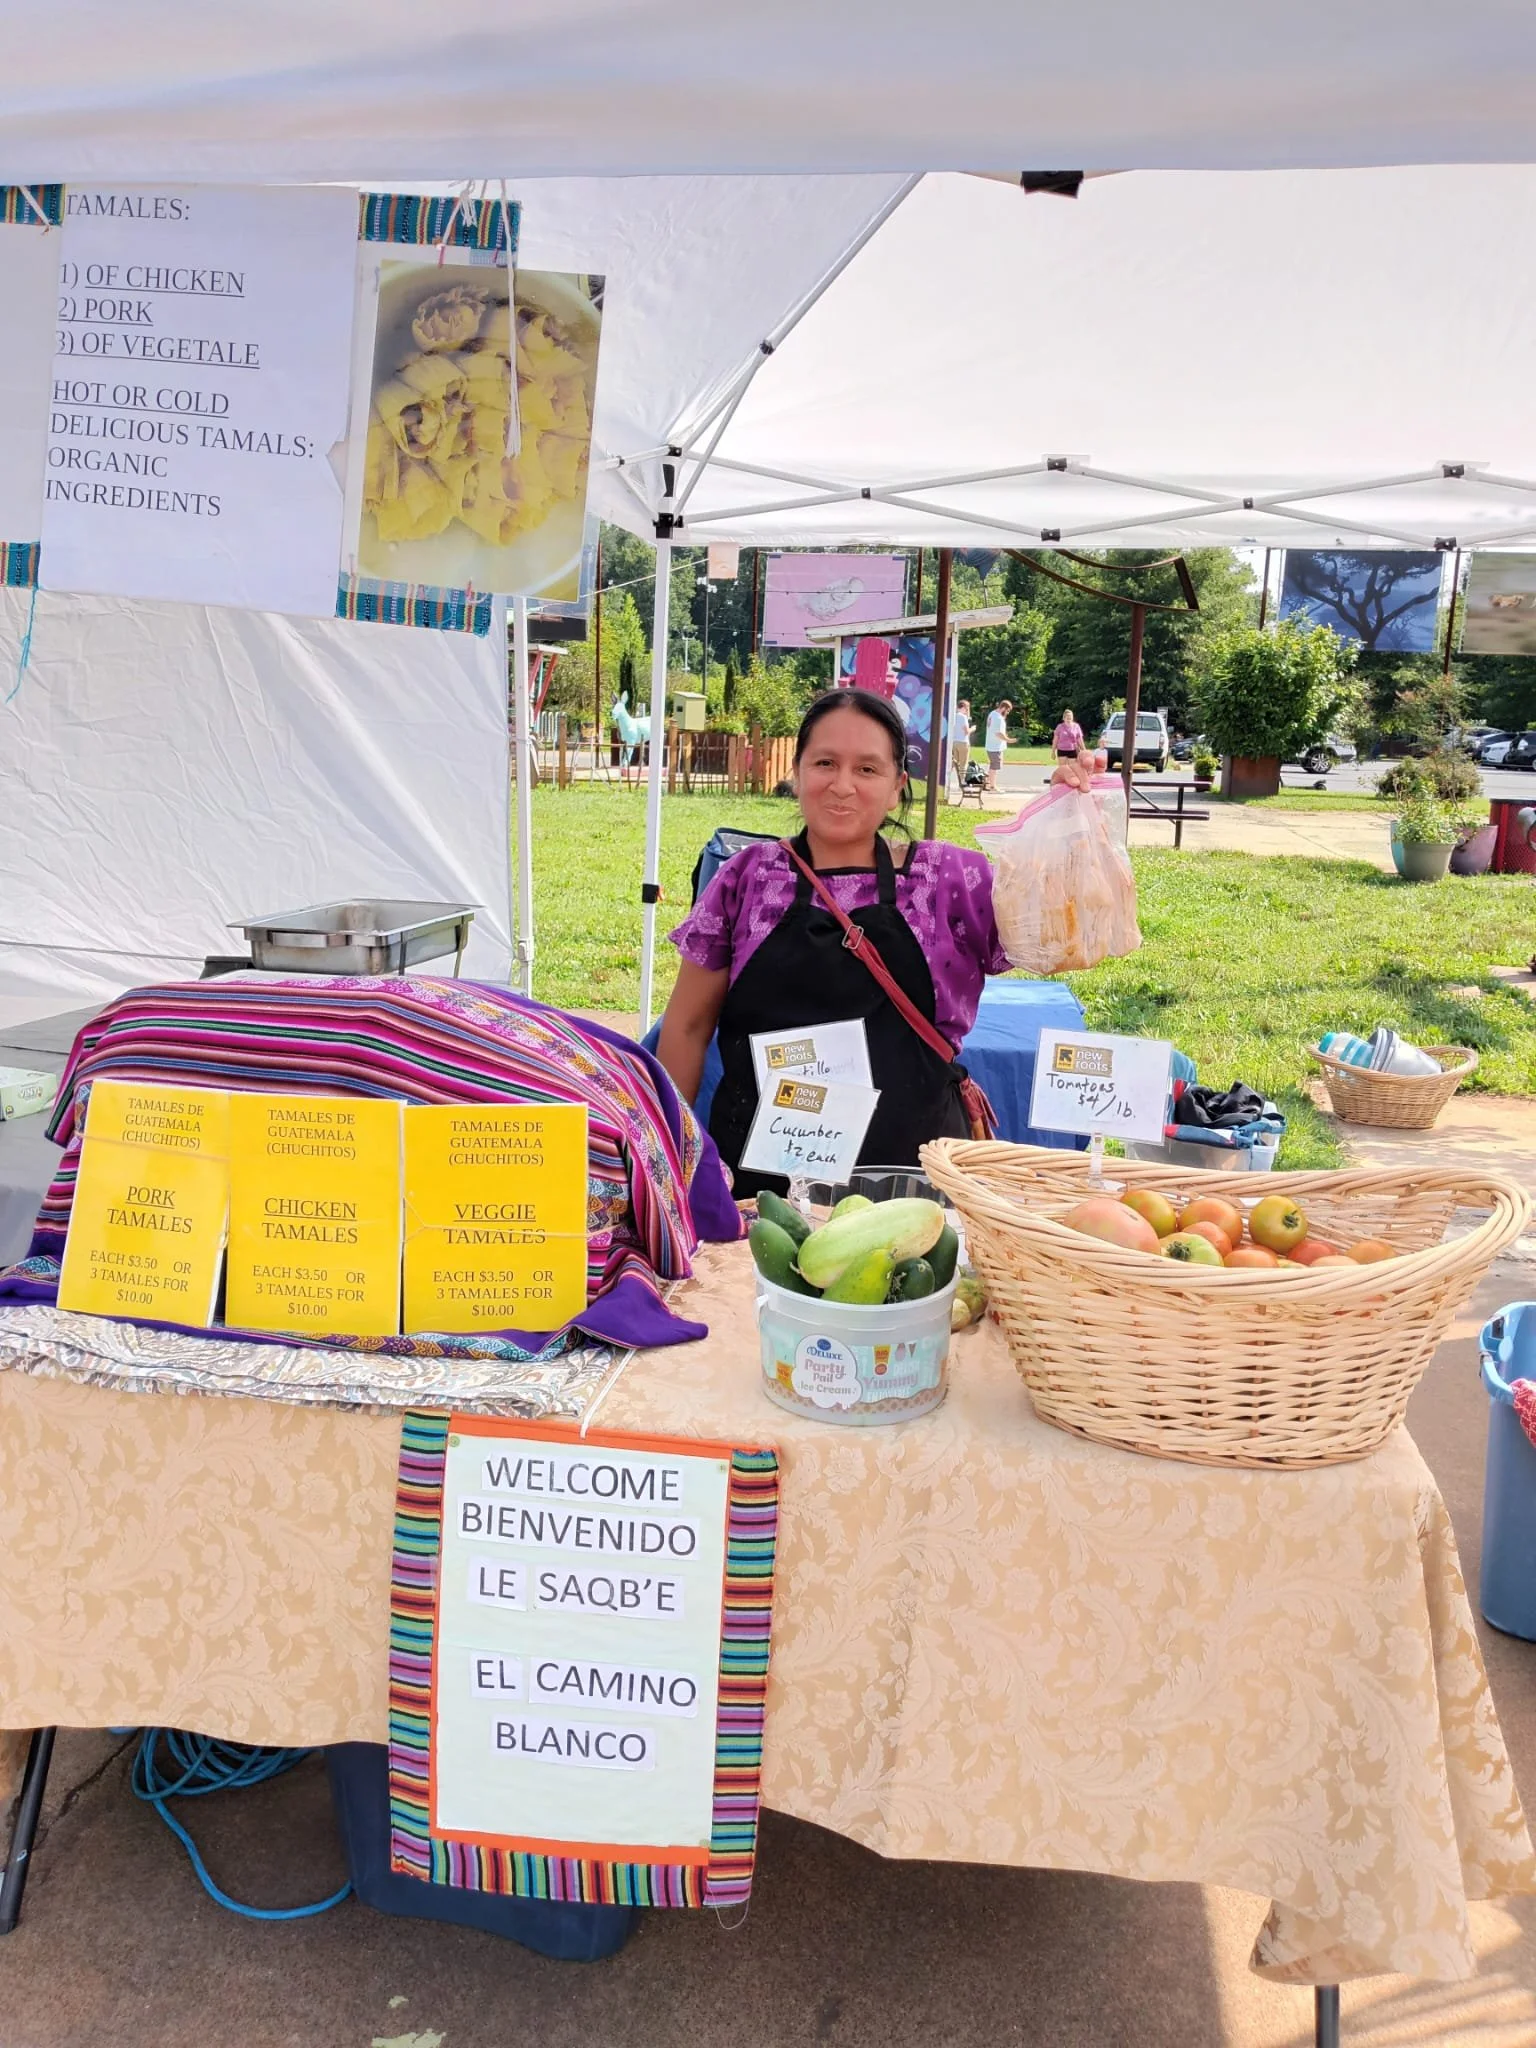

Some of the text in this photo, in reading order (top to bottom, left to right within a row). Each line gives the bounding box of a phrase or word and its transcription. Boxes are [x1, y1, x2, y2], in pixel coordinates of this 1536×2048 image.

[66, 194, 190, 222] TAMALES:
[59, 263, 245, 295] 1) OF CHICKEN
[58, 298, 153, 323] 2) PORK
[81, 332, 115, 356] OF
[122, 335, 260, 366] VEGETALE
[53, 380, 230, 415] HOT OR COLD
[50, 413, 315, 458] DELICIOUS TAMALS:
[47, 447, 169, 479] ORGANIC
[45, 479, 221, 517] INGREDIENTS
[784, 1044, 805, 1054] new
[785, 1051, 812, 1062] roots
[1076, 1048, 1103, 1060] new
[1076, 1060, 1108, 1072] roots
[796, 1087, 818, 1097] new
[128, 1097, 204, 1117] TAMALES DE
[793, 1096, 821, 1109] roots
[125, 1114, 202, 1132] GUATEMALA
[267, 1108, 355, 1125] TAMALES DE
[267, 1125, 355, 1142] GUATEMALA
[450, 1120, 543, 1133] TAMALES DE
[769, 1117, 843, 1139] Cucumber
[122, 1129, 201, 1151] (CHUCHITOS)
[450, 1137, 543, 1150] GUATEMALA
[266, 1141, 356, 1161] (CHUCHITOS)
[448, 1152, 544, 1168] (CHUCHITOS)
[806, 1151, 836, 1163] each
[126, 1186, 176, 1208] PORK
[264, 1197, 357, 1219] CHICKEN
[454, 1203, 536, 1220] VEGGIE
[107, 1208, 193, 1235] TAMALES
[262, 1221, 358, 1244] TAMALES
[443, 1227, 547, 1245] TAMALES
[89, 1249, 192, 1274] EACH $3.50 OR
[90, 1267, 189, 1292] 3 TAMALES FOR
[253, 1265, 366, 1284] EACH $3.50 OR
[433, 1269, 554, 1283] EACH $3.50 OR
[116, 1290, 153, 1305] $10.00
[256, 1282, 365, 1301] 3 TAMALES FOR
[436, 1285, 553, 1299] 3 TAMALES FOR
[287, 1302, 328, 1317] $10.00
[471, 1303, 514, 1318] $10.00
[807, 1346, 843, 1360] DELUXE
[804, 1359, 847, 1379] Party
[813, 1373, 833, 1382] Pail
[485, 1456, 680, 1501] WELCOME
[461, 1502, 696, 1556] BIENVENIDO
[478, 1567, 516, 1599] LE
[476, 1659, 697, 1707] EL CAMINO
[496, 1721, 647, 1762] BLANCO
